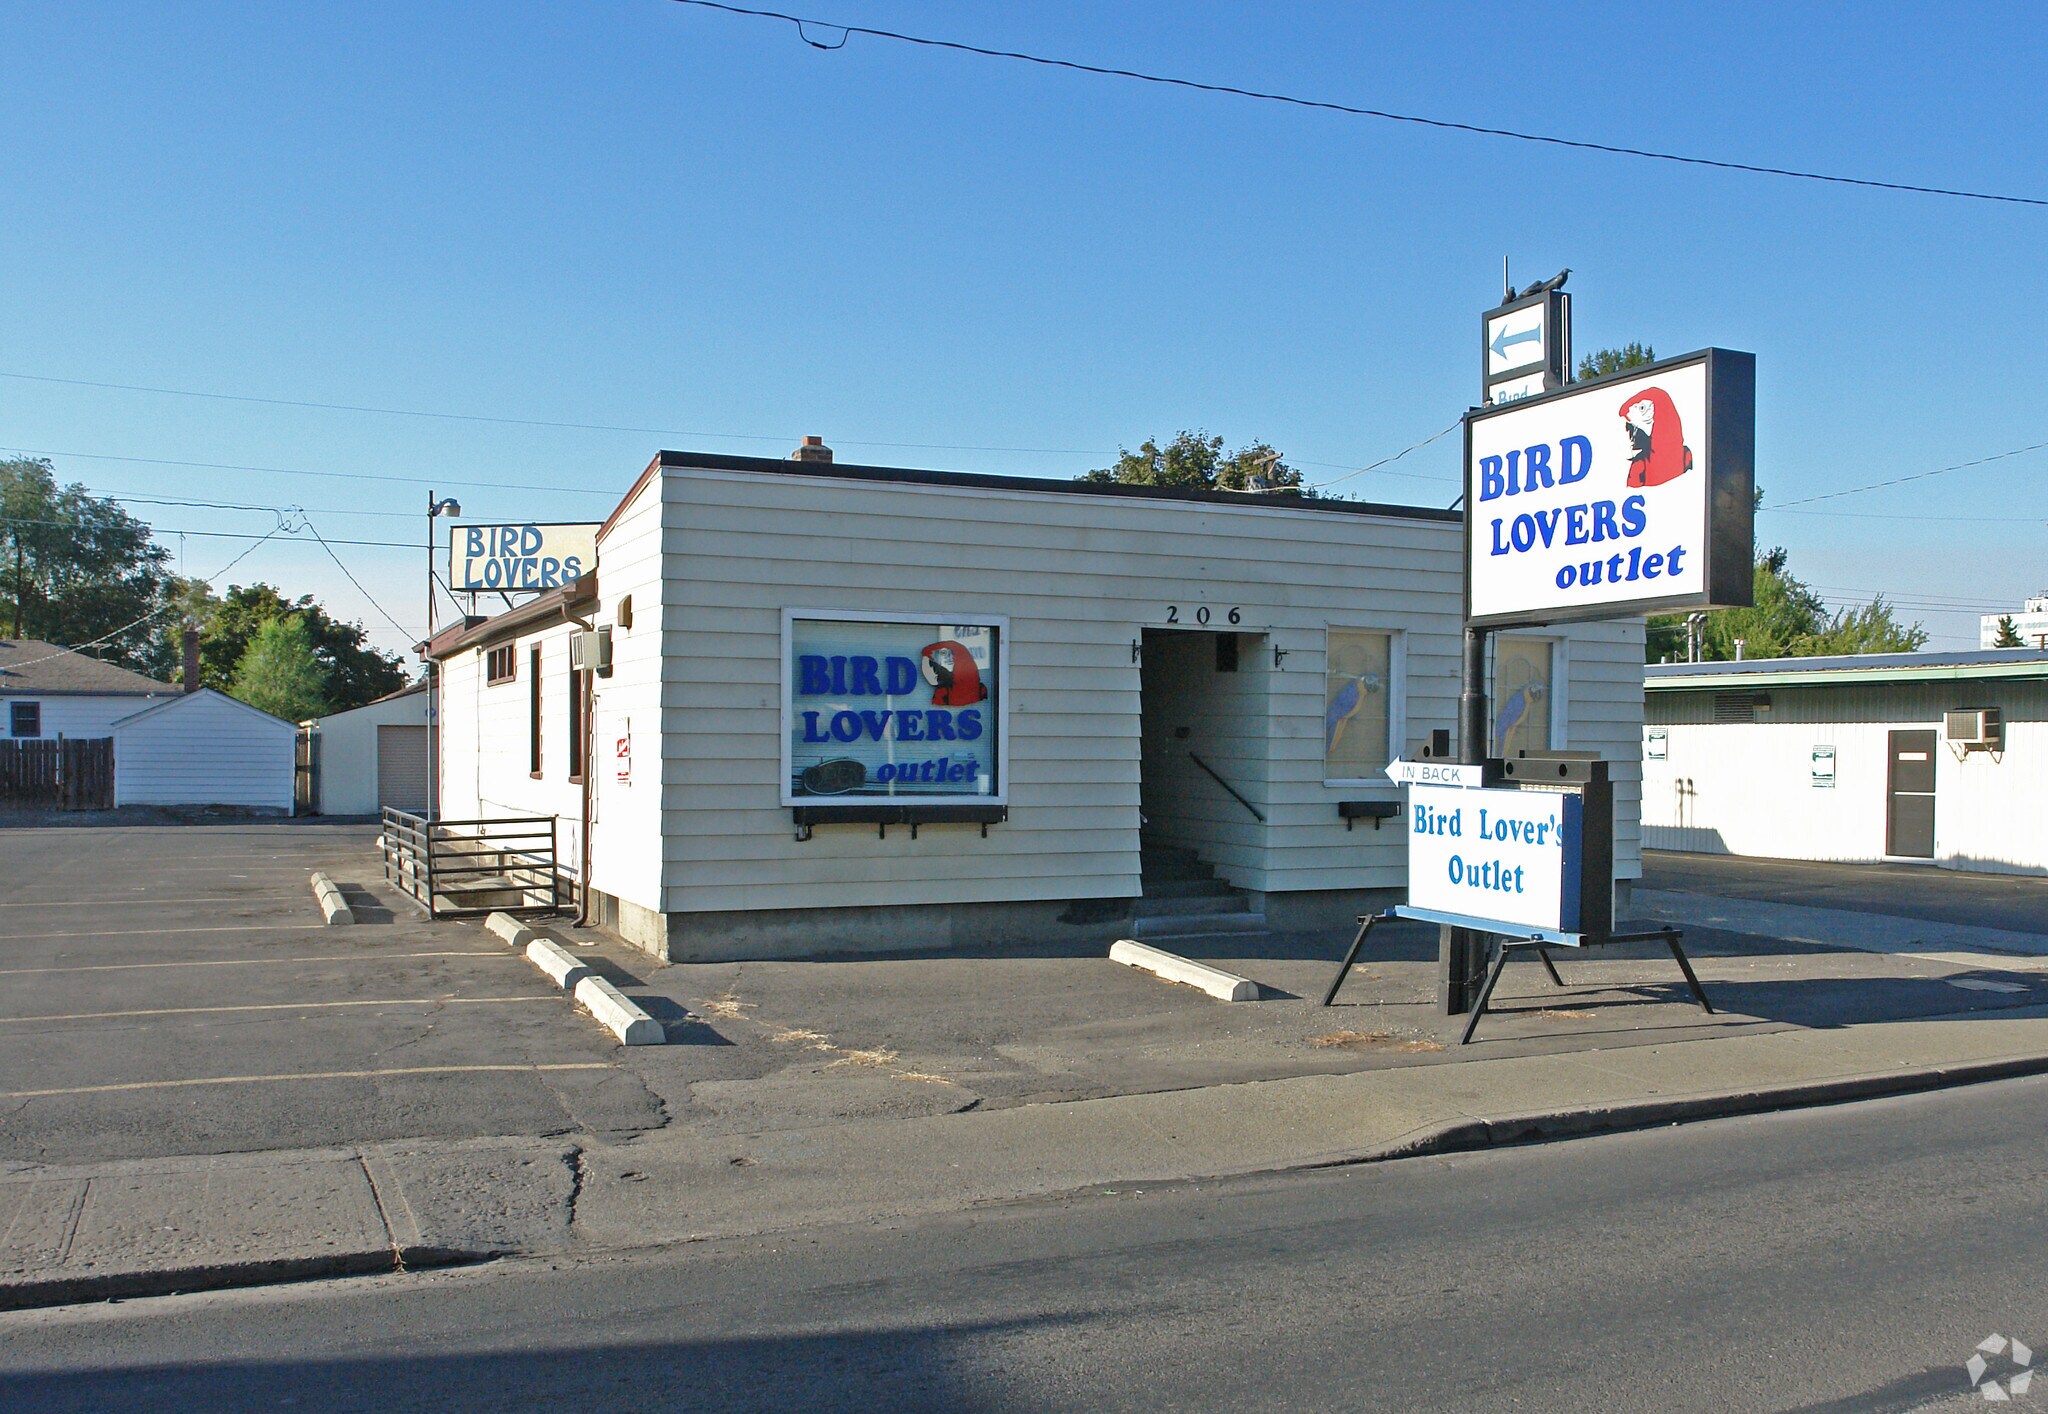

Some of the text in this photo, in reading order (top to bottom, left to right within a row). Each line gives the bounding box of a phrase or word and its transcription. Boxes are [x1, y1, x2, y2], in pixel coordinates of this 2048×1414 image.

[1479, 435, 1592, 501] BIRD
[1490, 494, 1647, 556] LOVERS
[466, 526, 543, 558] BIRD
[464, 556, 581, 588] LOVERS
[1555, 545, 1687, 589] outlet
[1166, 605, 1241, 625] 206
[799, 655, 917, 695] BIRD
[802, 709, 983, 743] LOVERS
[877, 757, 980, 783] outlet
[1402, 766, 1461, 782] IN BACK
[1413, 804, 1462, 837] Bird
[1448, 855, 1524, 893] Outlet
